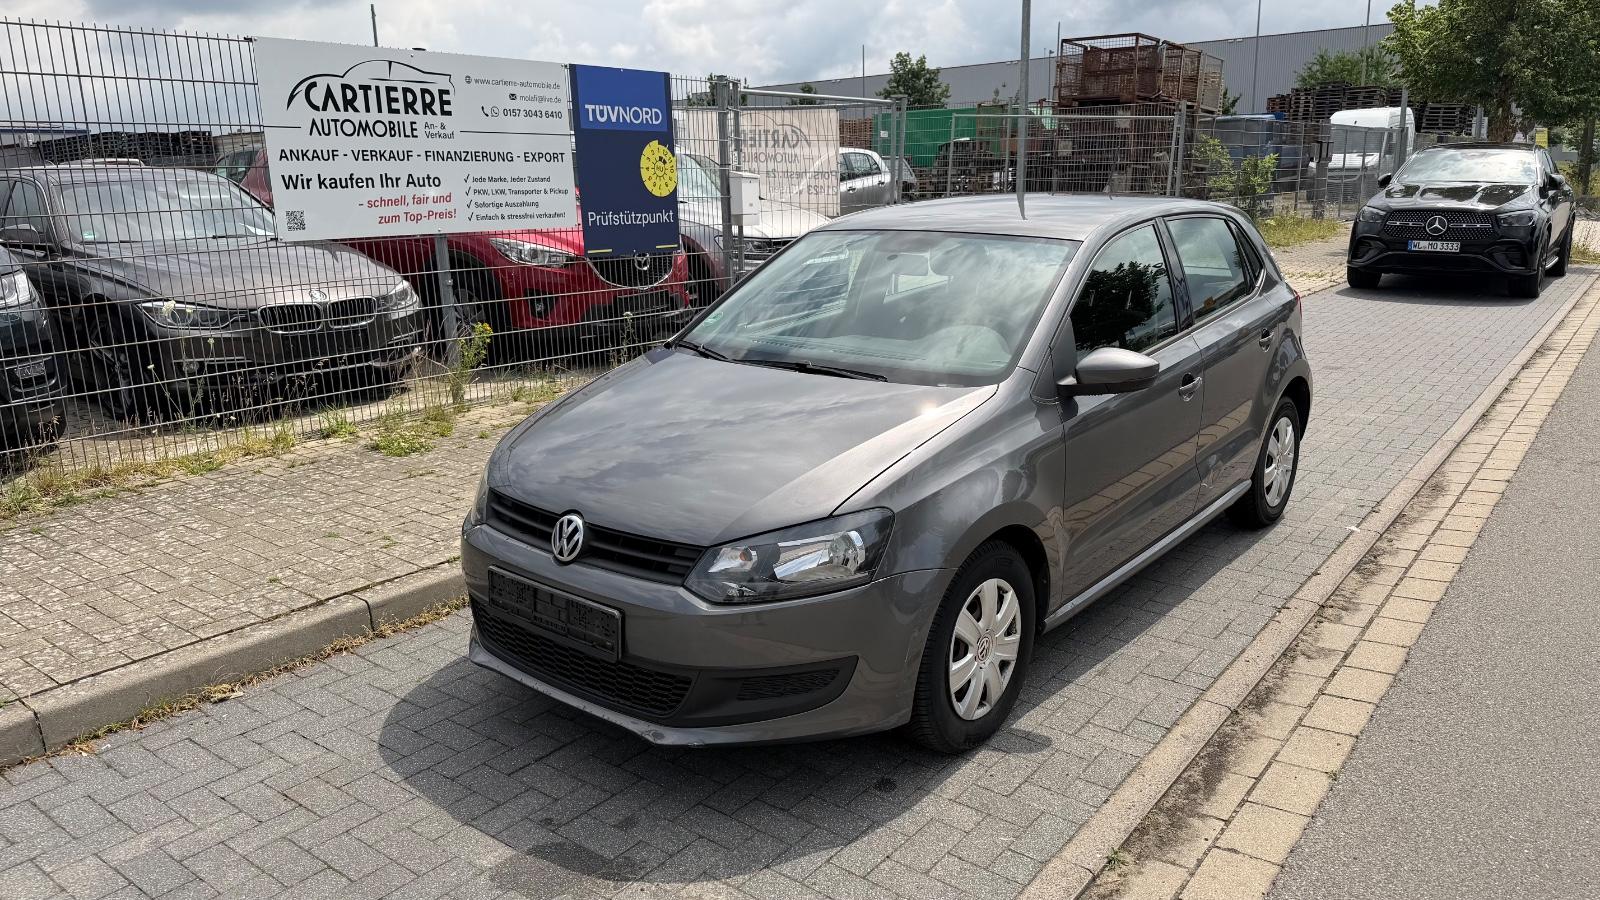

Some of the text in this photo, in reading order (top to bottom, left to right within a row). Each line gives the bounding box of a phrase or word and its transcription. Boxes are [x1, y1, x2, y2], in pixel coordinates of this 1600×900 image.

[304, 81, 453, 117] CARTIERRE
[503, 108, 563, 119] 0157 3043 6410
[309, 118, 419, 138] AUTOMOBILE
[439, 122, 447, 130] &
[424, 130, 455, 139] Verkauf
[279, 149, 339, 161] ANKAUF
[351, 150, 413, 161] VERKAUF
[425, 150, 514, 162] FINANZIERUNG
[524, 152, 565, 163] EXPORT
[281, 173, 441, 190] Wir kaufen Ihr Auto
[474, 188, 490, 196] PKW,
[491, 188, 507, 196] LKW,
[508, 188, 542, 196] Transporter
[367, 195, 409, 208] schnell,
[412, 193, 430, 205] fair
[432, 192, 452, 204] und
[474, 200, 539, 209] Sofortige Auszahlung
[378, 208, 457, 224] zum Top-Preis!
[507, 212, 535, 220] stressfrei
[535, 211, 566, 219] verkaufen!
[588, 209, 674, 227] Prüfstützpunkt
[1440, 242, 1460, 250] 3333
